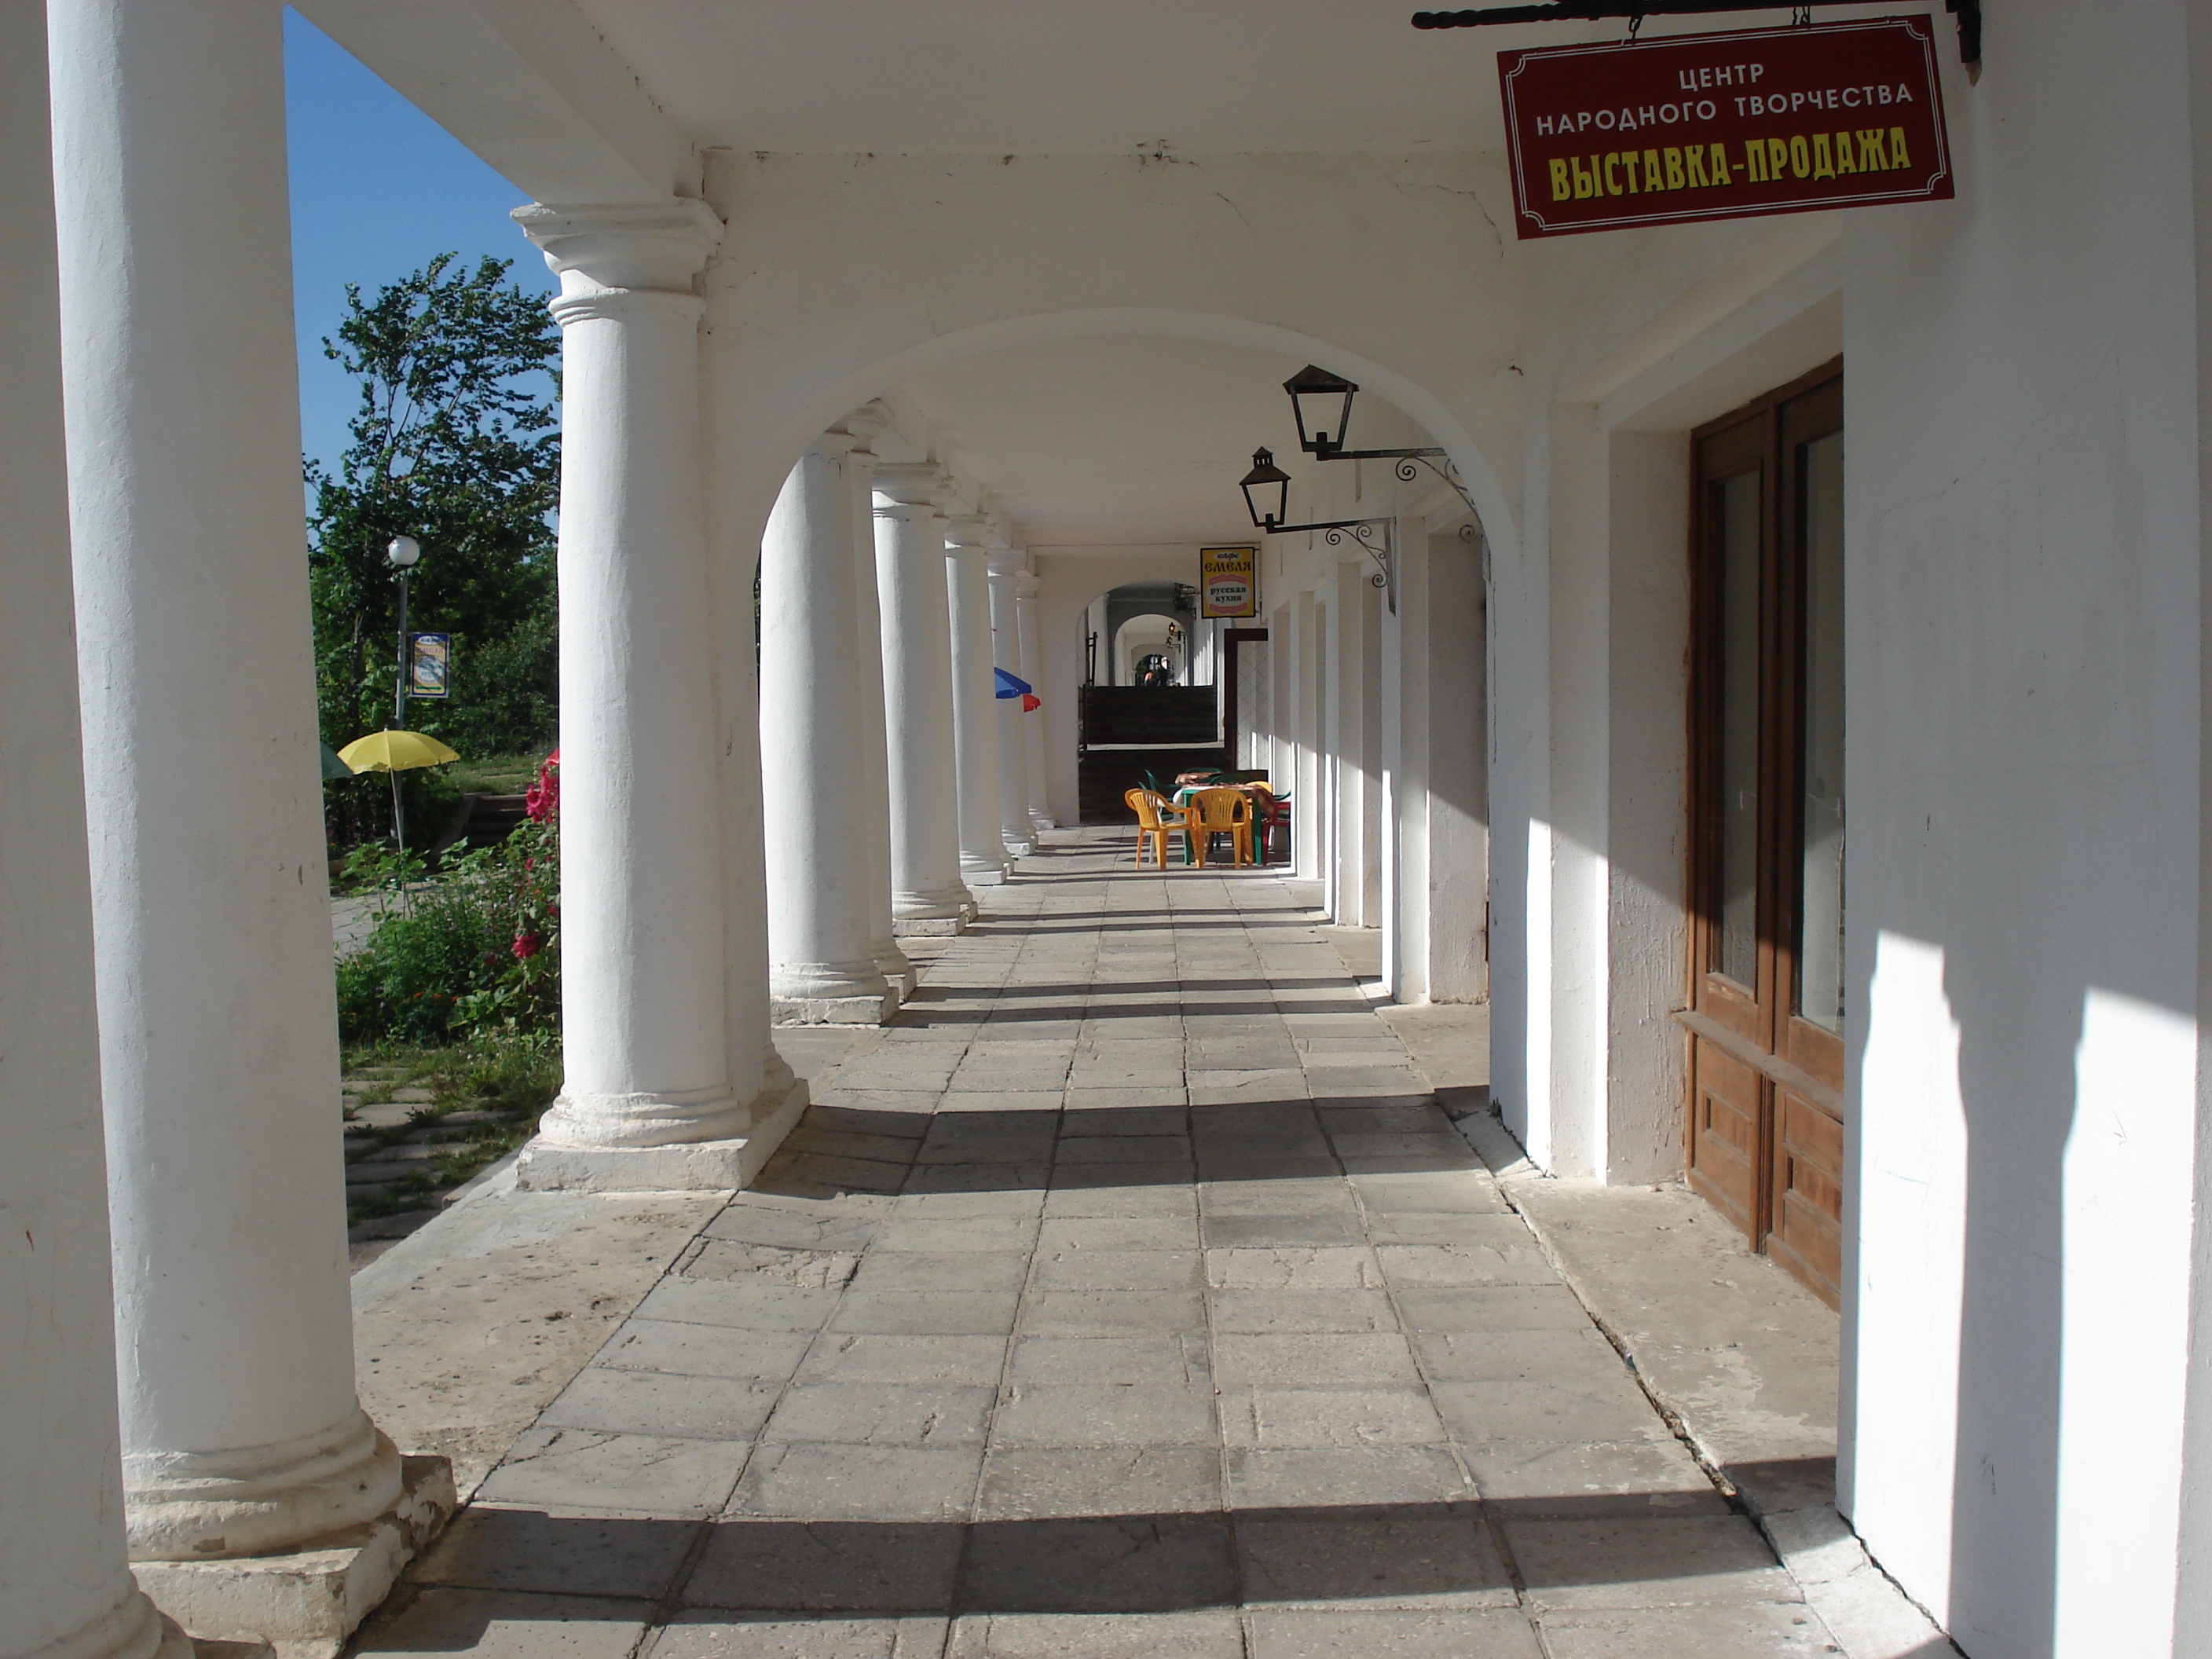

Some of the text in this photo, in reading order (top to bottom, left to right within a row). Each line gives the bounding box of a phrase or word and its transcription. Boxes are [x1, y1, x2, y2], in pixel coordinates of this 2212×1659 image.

[1678, 64, 1765, 92] ЦЕНТР
[1536, 82, 1914, 136] НАРОДНОГО ТВОРЧЕСТВА
[1548, 126, 1911, 203] ВЫСТАВКА-ПРОДАЖА
[1210, 587, 1246, 595] русская
